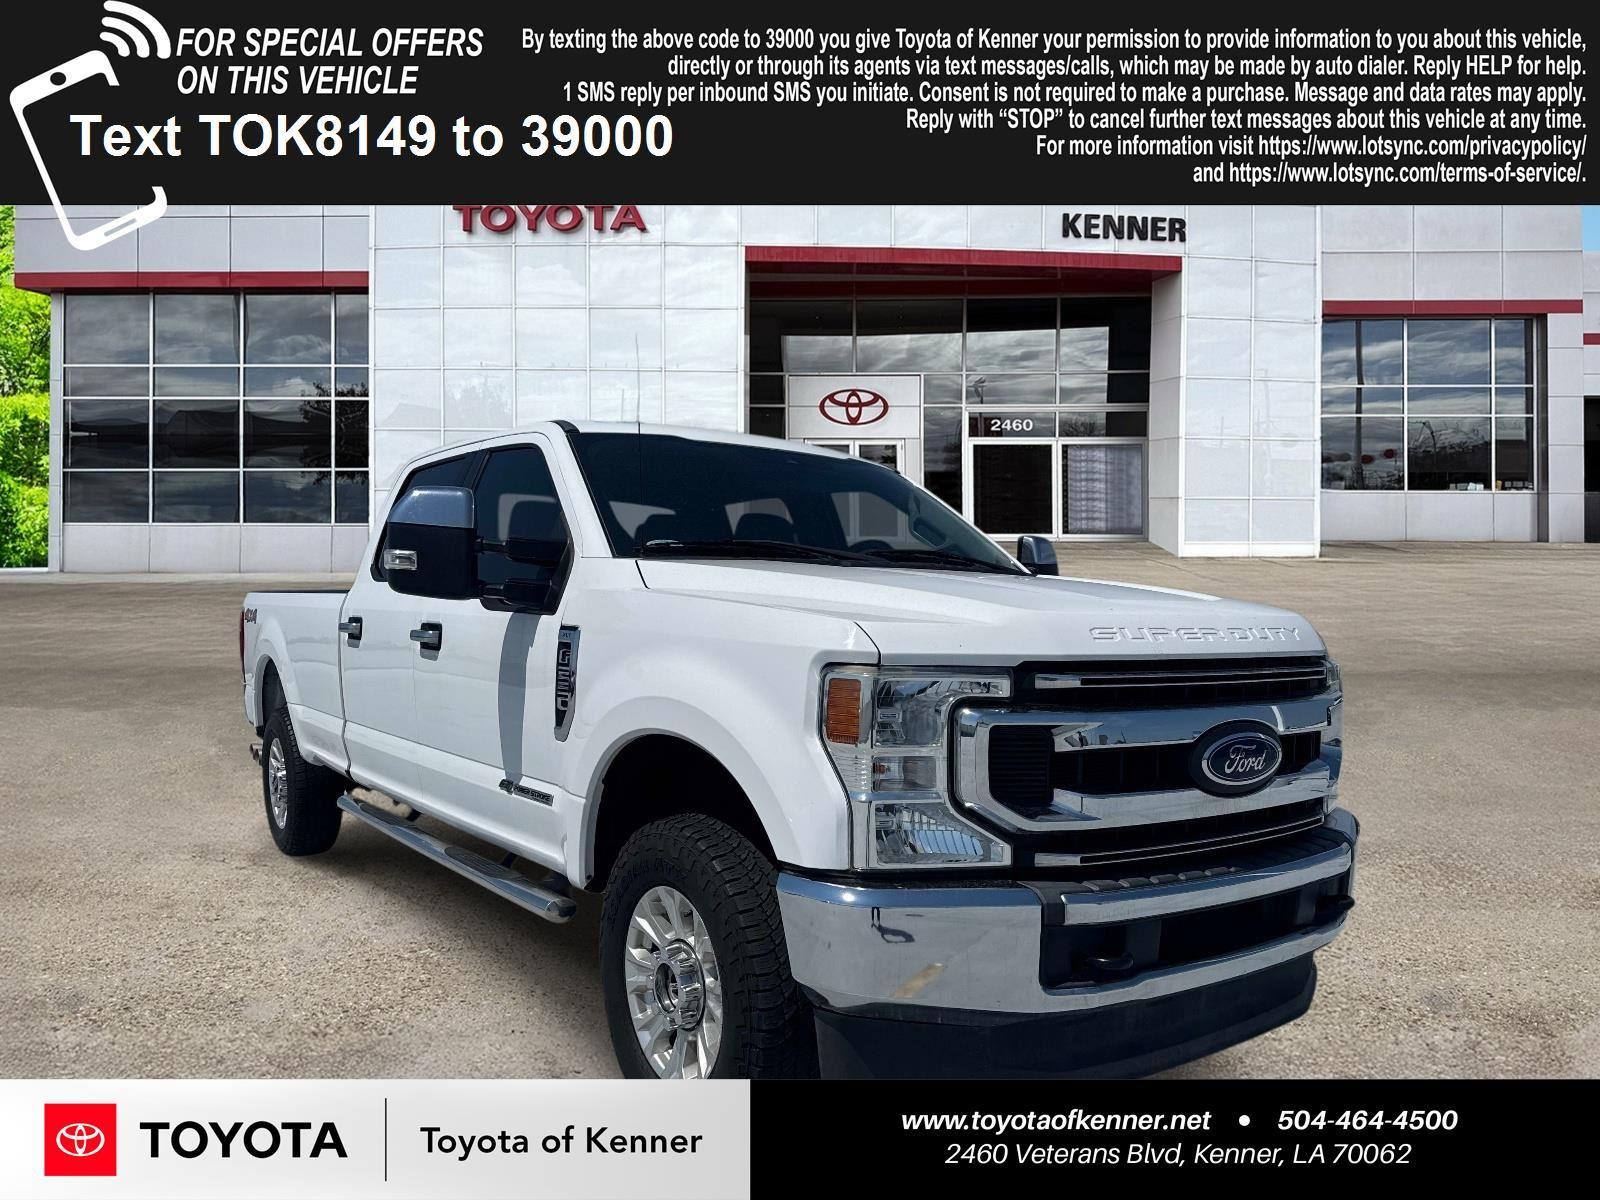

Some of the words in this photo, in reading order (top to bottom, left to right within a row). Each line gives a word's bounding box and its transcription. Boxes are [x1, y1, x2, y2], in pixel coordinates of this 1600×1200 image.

[453, 205, 647, 233] TOYOTA
[1062, 213, 1187, 242] KENNER
[990, 419, 1033, 431] 2460
[1225, 744, 1267, 774] Ford
